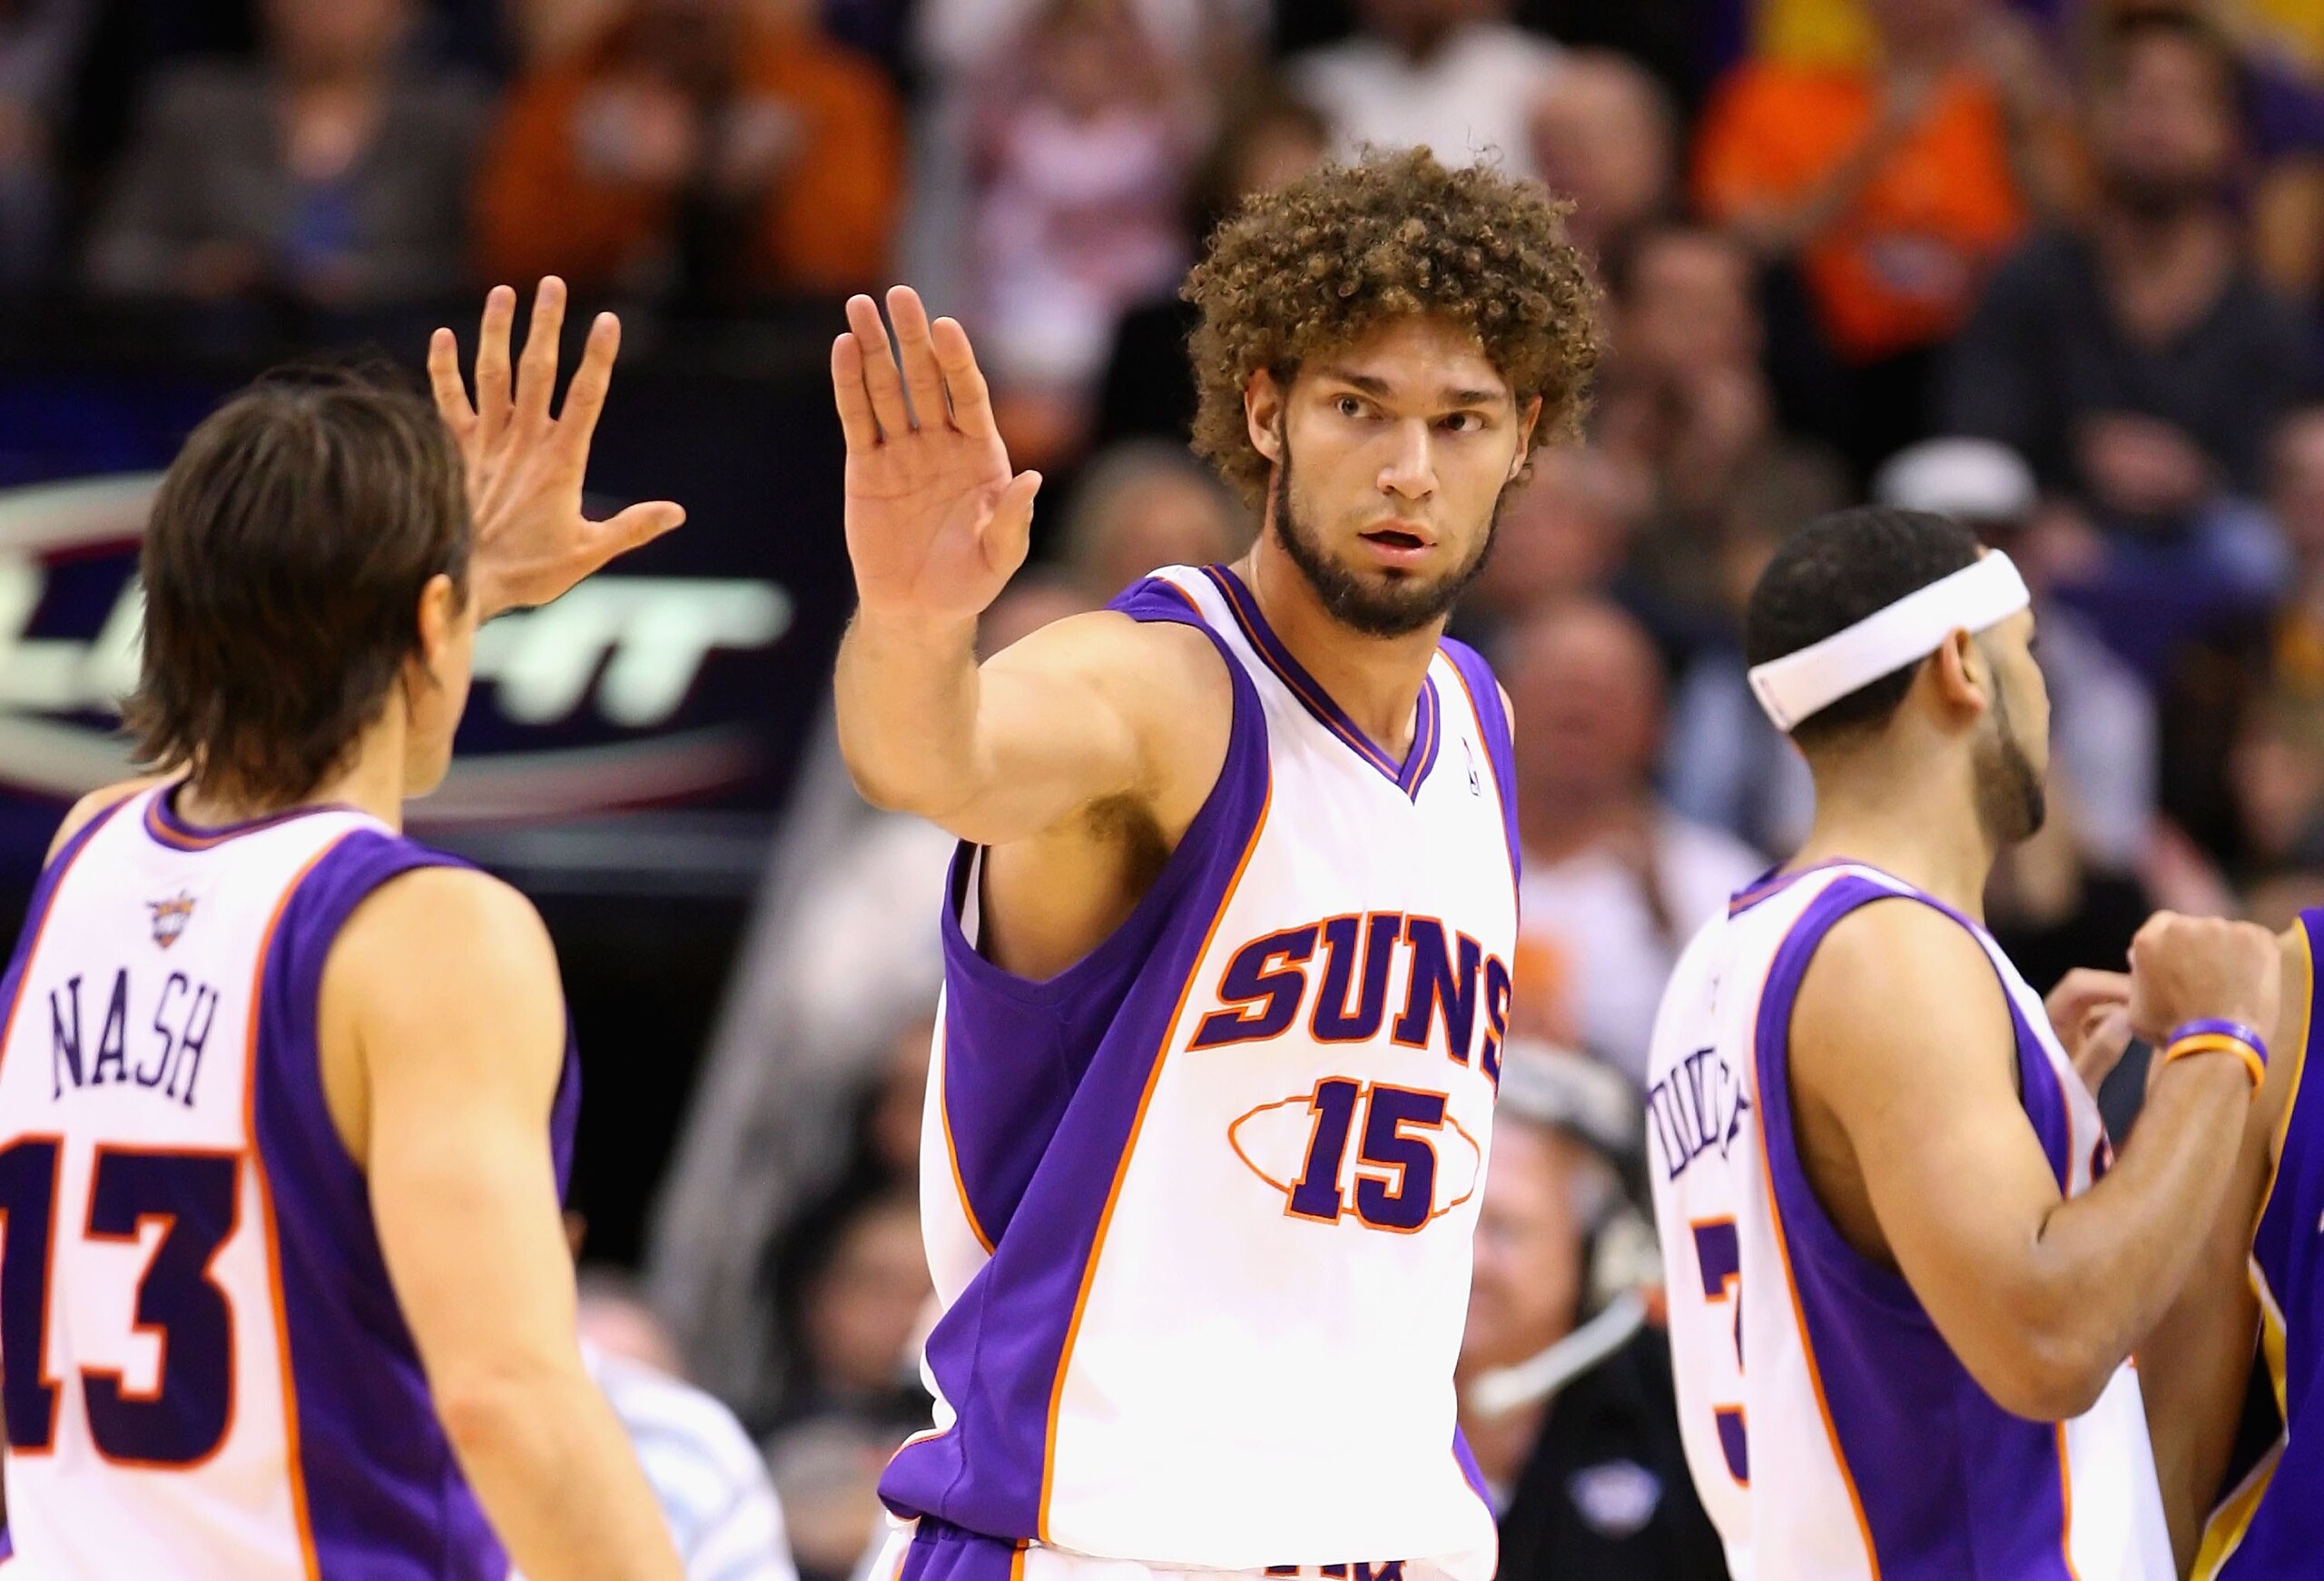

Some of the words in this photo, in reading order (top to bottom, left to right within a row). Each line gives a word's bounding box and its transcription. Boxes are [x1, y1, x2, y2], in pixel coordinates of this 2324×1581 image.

[50, 967, 218, 1107] NASH
[1185, 910, 1512, 1105] SUNS
[1284, 1075, 1450, 1234] 15
[0, 1131, 243, 1472] 13
